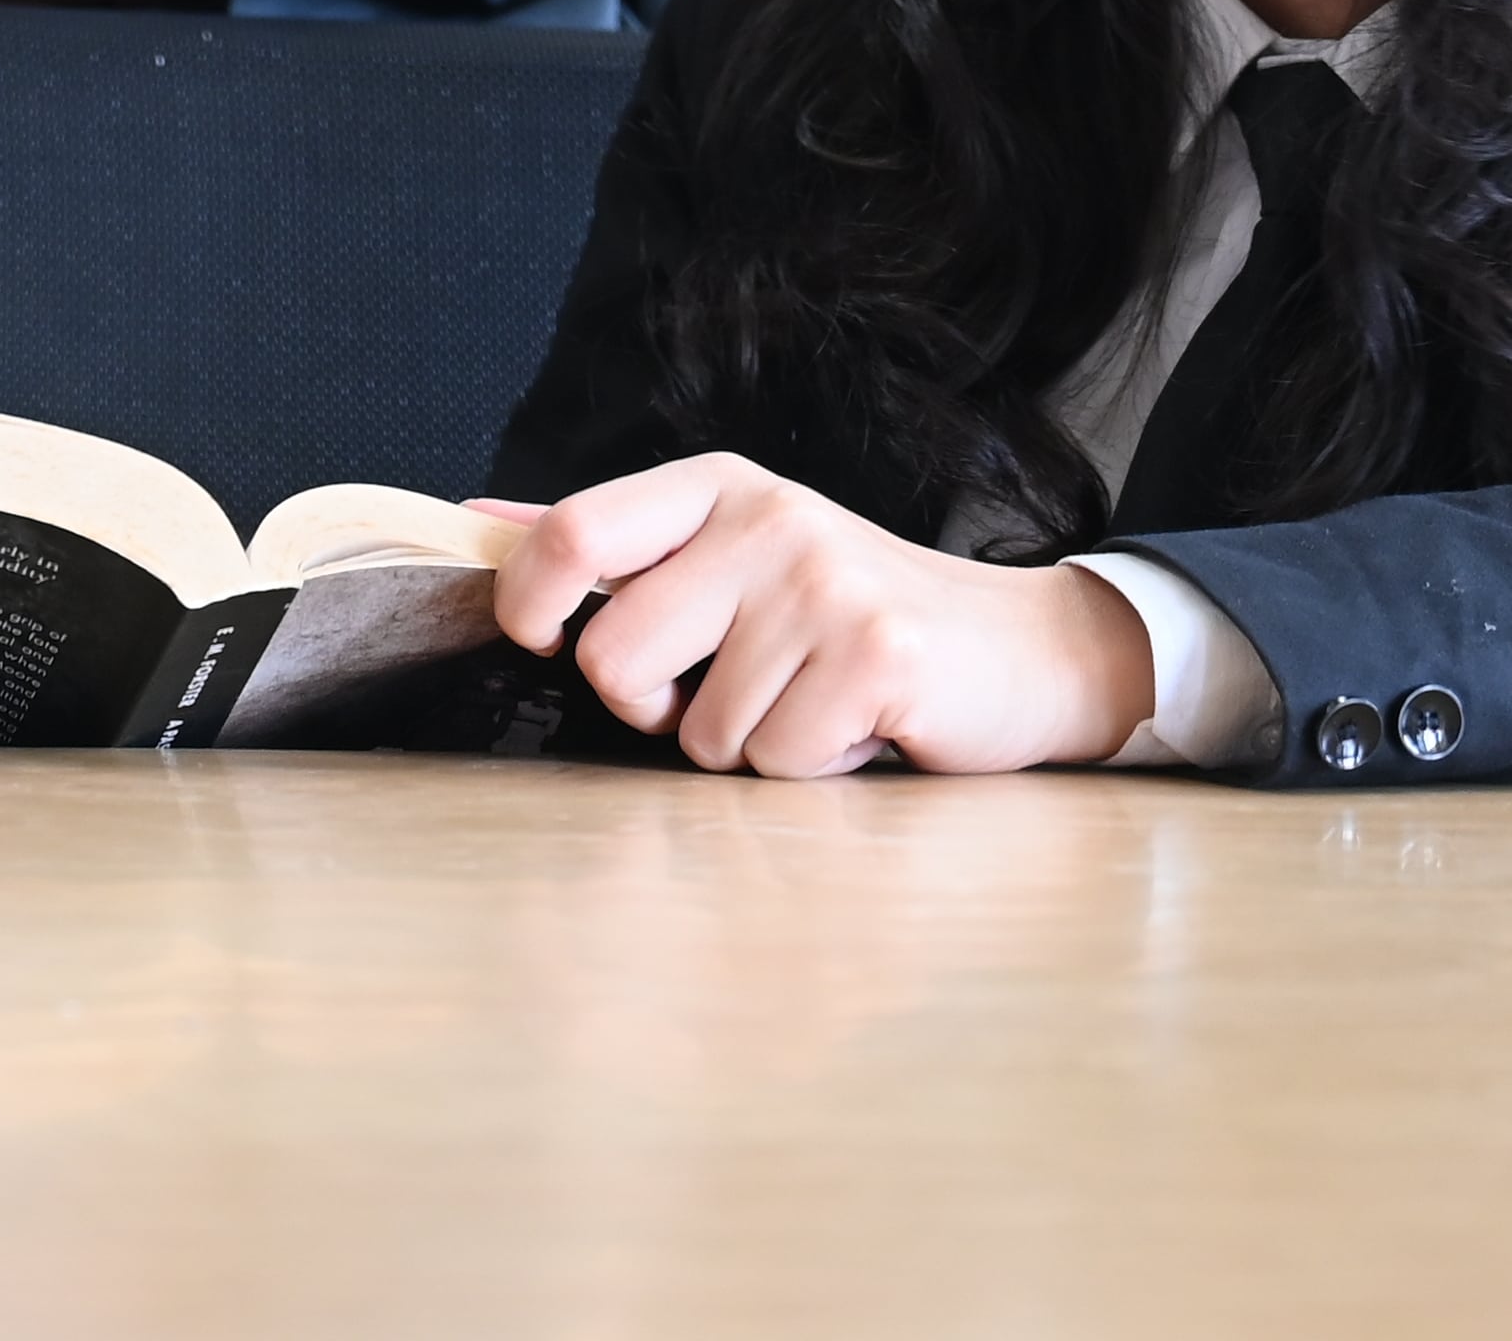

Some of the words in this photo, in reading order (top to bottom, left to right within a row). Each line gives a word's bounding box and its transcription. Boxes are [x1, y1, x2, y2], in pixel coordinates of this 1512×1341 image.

[37, 555, 59, 572] in
[9, 613, 43, 633] grip
[49, 630, 68, 643] of
[27, 632, 59, 654] fate
[4, 651, 47, 678] when
[22, 646, 55, 666] and
[4, 679, 37, 699] and
[176, 658, 218, 709] FORSTER
